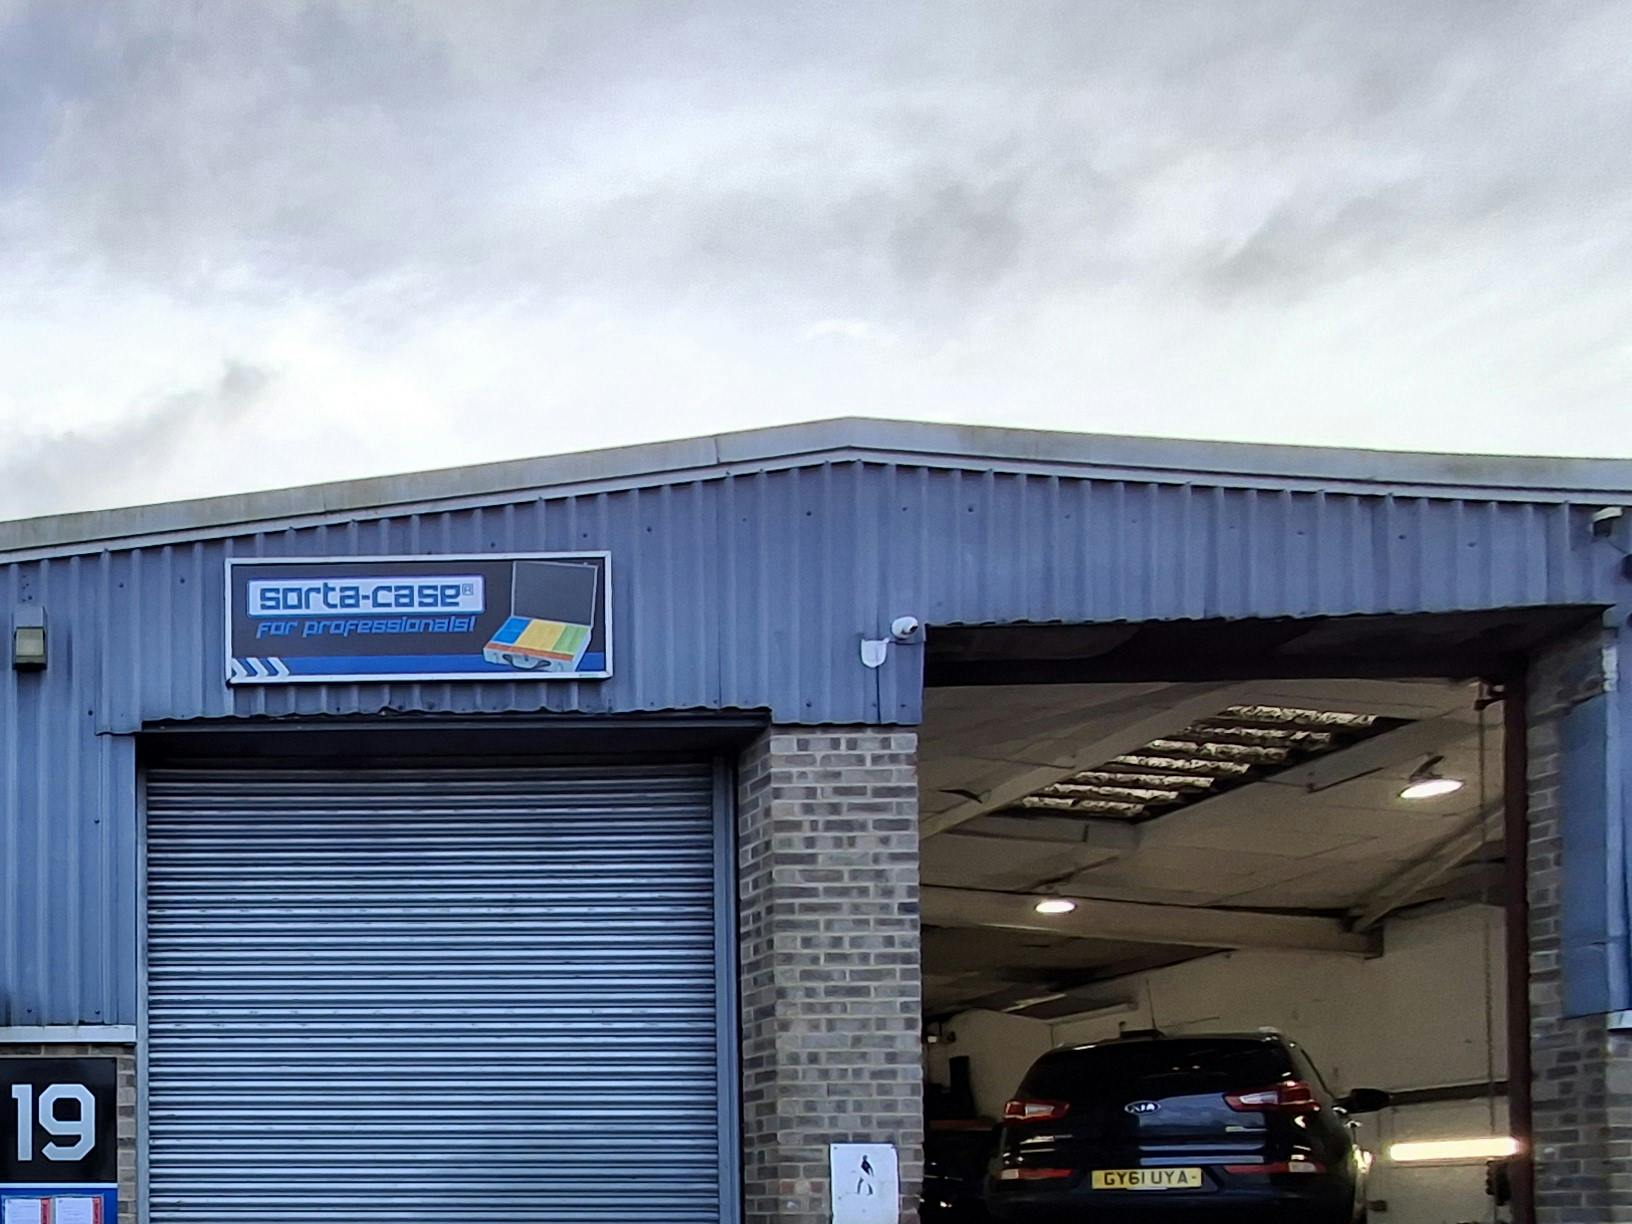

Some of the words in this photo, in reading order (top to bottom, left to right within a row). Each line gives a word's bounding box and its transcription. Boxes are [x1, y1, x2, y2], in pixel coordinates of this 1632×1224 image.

[256, 621, 298, 639] for
[302, 616, 476, 638] professionals!
[11, 1083, 96, 1161] 19
[1104, 1171, 1145, 1186] GY61
[1151, 1169, 1188, 1185] UYA
